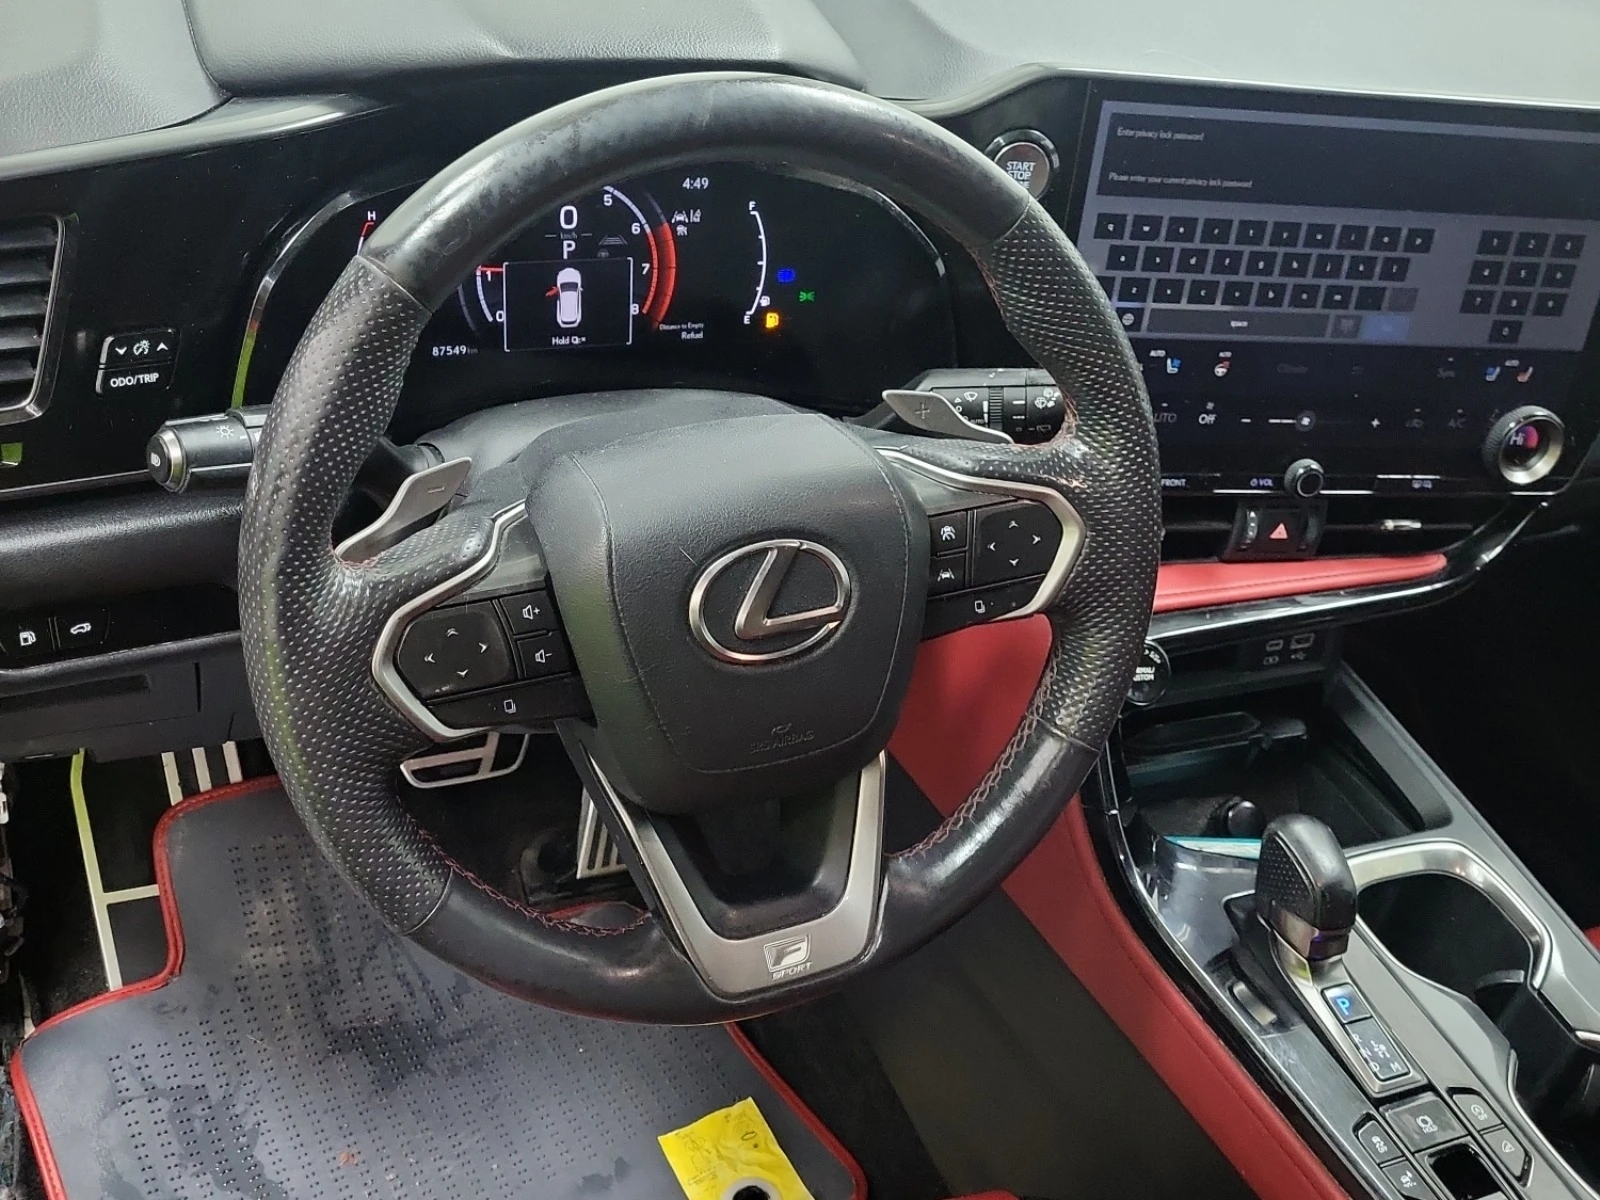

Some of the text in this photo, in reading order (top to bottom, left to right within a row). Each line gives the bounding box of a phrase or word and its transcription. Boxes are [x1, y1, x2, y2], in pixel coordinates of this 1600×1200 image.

[1006, 161, 1036, 171] START
[1007, 171, 1031, 181] STOP
[682, 177, 710, 190] 4:49
[603, 194, 613, 206] 5
[748, 201, 756, 210] F
[367, 211, 376, 220] H
[560, 205, 578, 229] 0
[631, 223, 641, 235] 6
[563, 240, 576, 260] P
[641, 263, 651, 275] 7
[485, 270, 492, 282] 1
[630, 303, 640, 315] 8
[495, 310, 504, 322] 0
[743, 316, 751, 324] E
[659, 323, 680, 331] Distance
[688, 321, 704, 330] Empty
[551, 335, 570, 346] Hold
[681, 331, 704, 340] Refuel
[432, 345, 467, 356] 87549
[110, 372, 160, 388] ODO/TRIP
[1198, 413, 1217, 425] Off
[1510, 431, 1525, 446] Hi
[1259, 478, 1274, 487] VOL
[772, 961, 814, 980] SPORT
[1335, 997, 1350, 1016] P
[1368, 1061, 1402, 1073] D M
